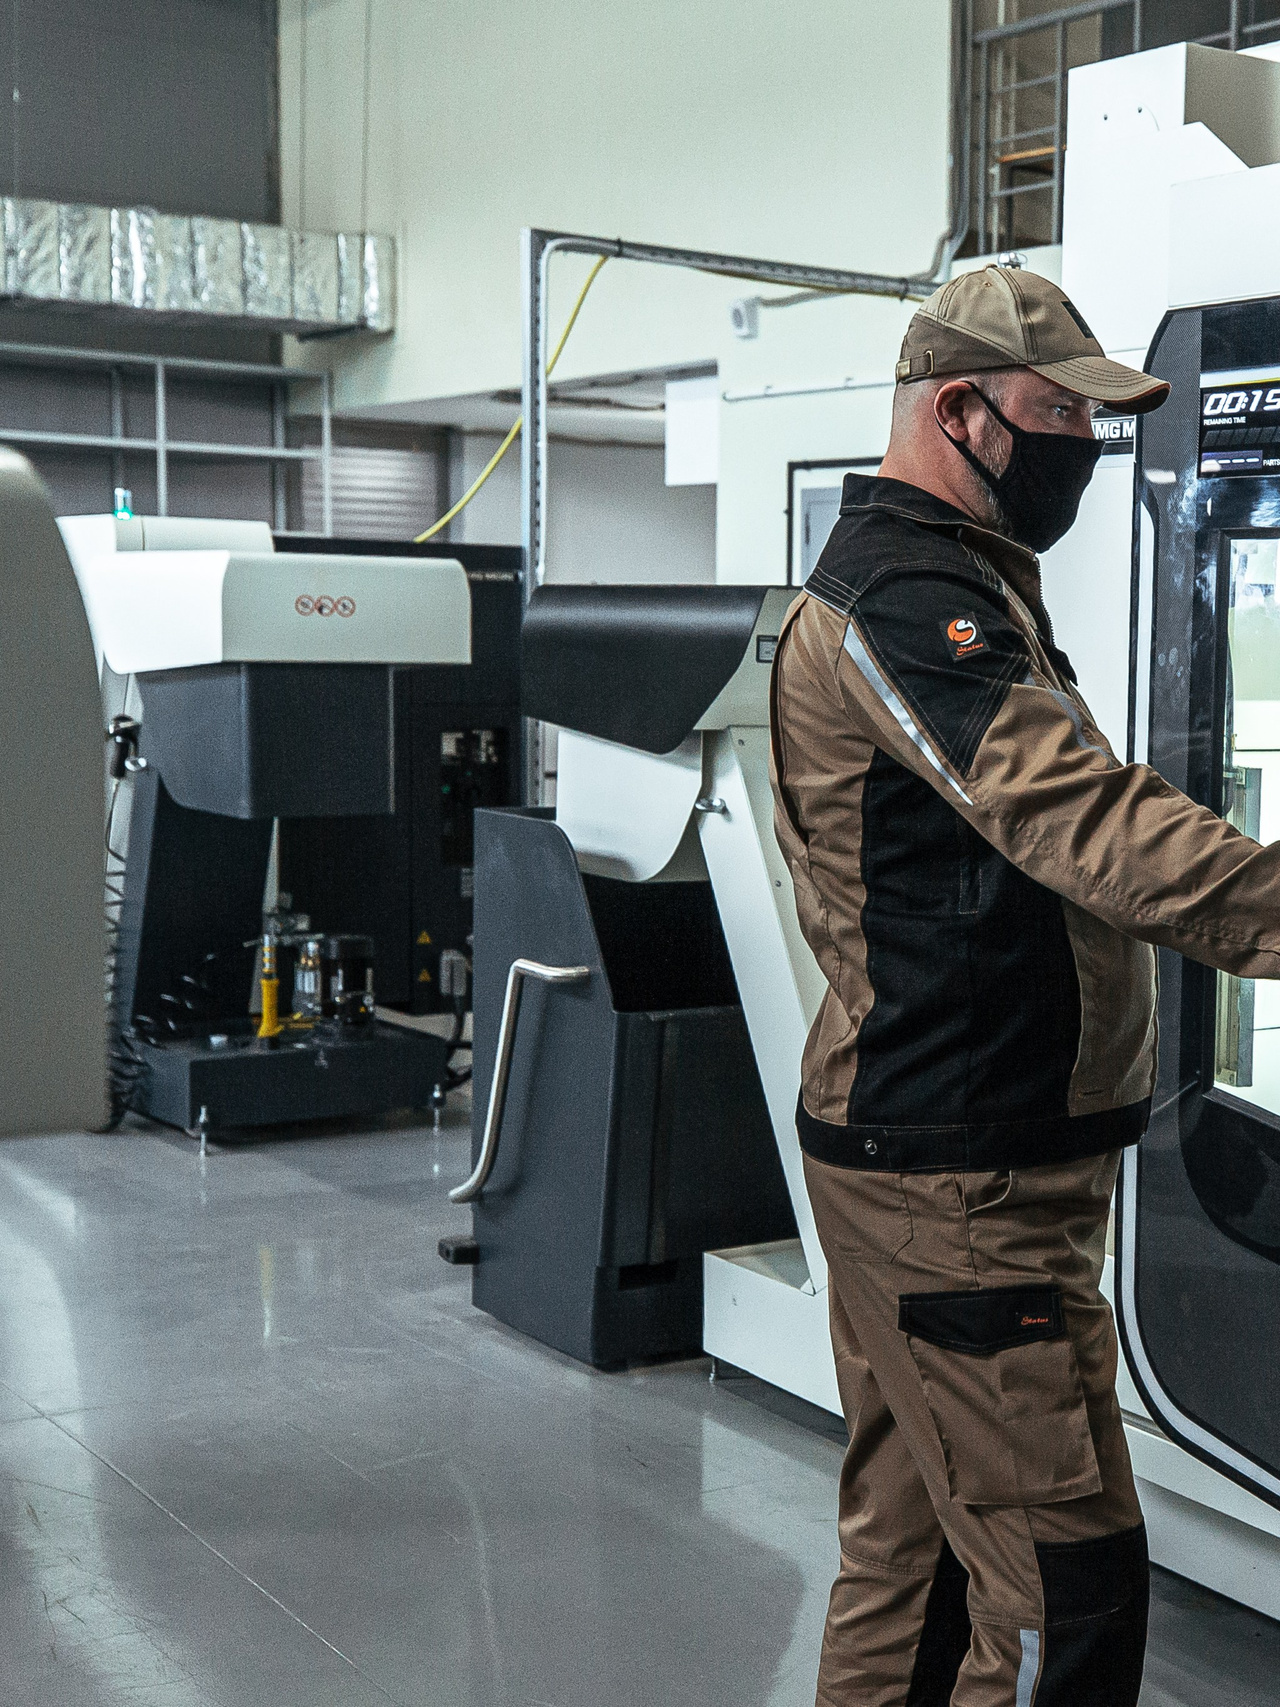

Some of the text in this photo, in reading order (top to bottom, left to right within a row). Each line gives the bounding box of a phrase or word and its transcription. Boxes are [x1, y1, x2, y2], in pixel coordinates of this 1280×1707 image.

[1203, 416, 1246, 426] REMAINING TIME
[1091, 421, 1121, 440] MG
[1262, 459, 1280, 467] PARTS
[956, 643, 984, 656] Status
